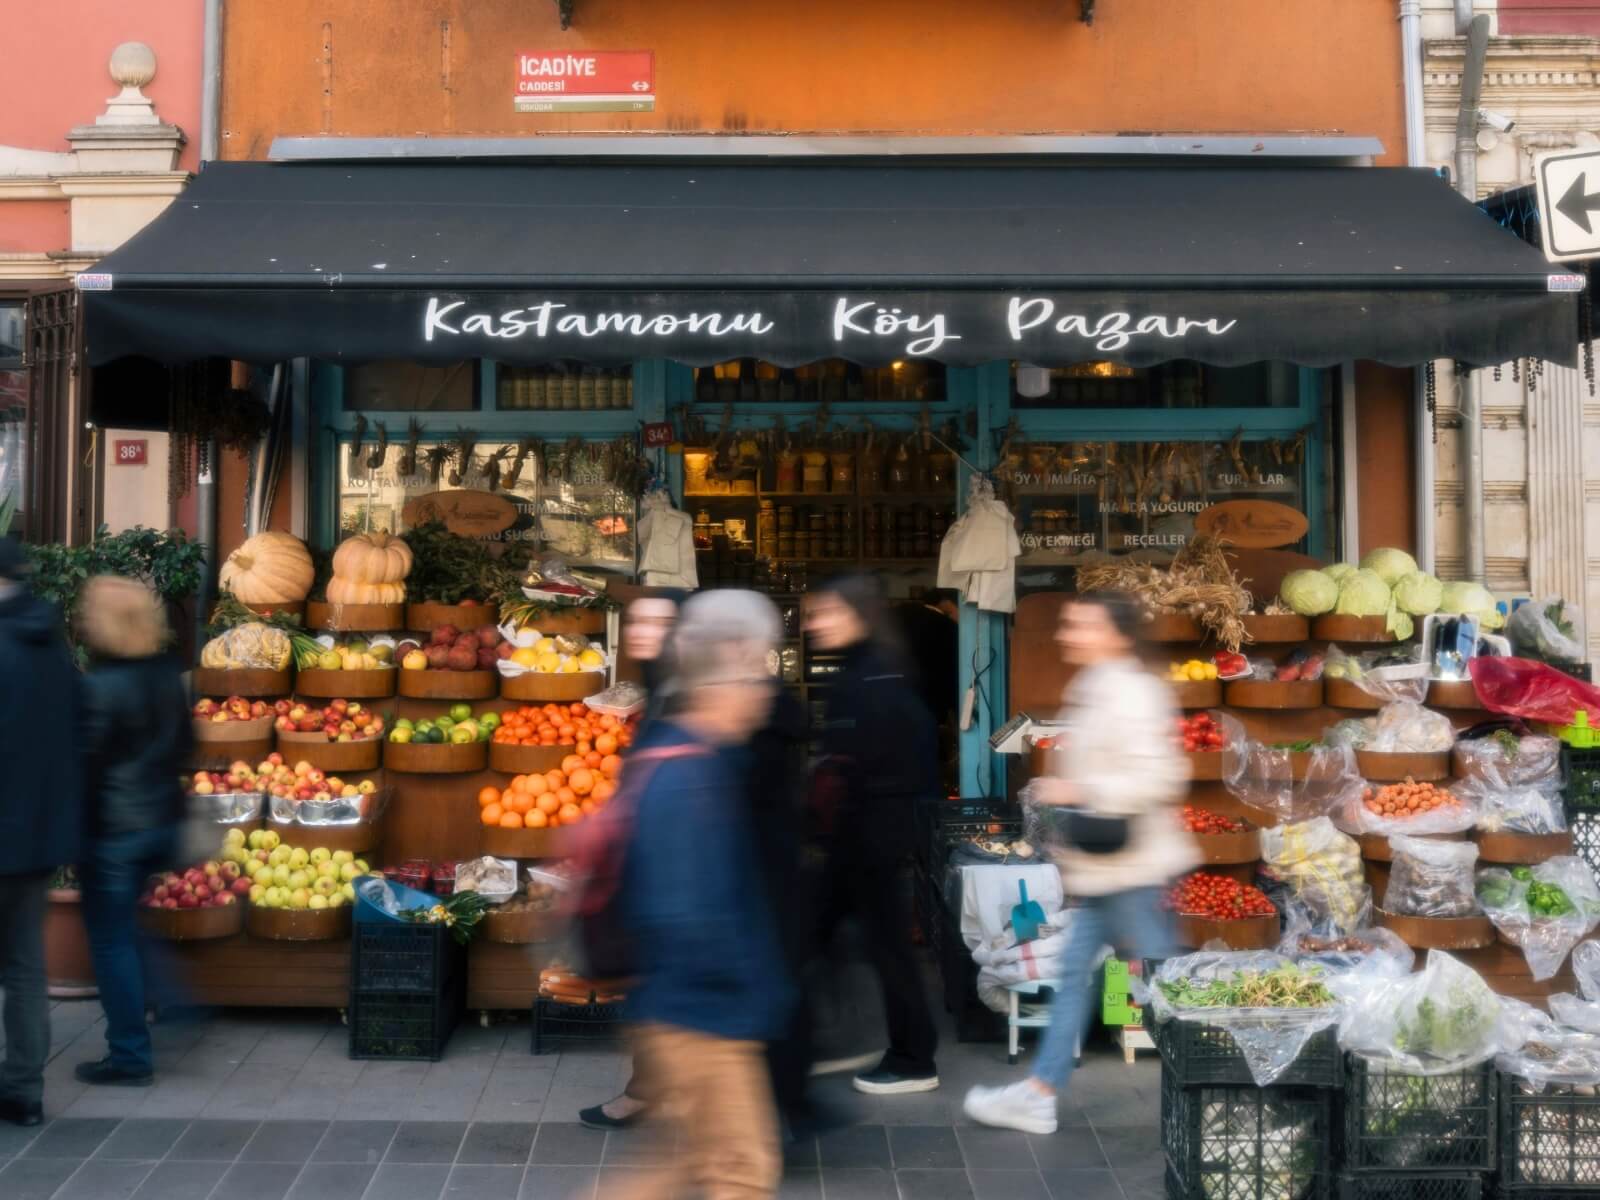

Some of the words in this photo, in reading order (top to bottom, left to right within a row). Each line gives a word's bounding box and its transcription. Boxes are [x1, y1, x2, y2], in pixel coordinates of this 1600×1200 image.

[520, 54, 596, 76] İCADİYE
[424, 297, 774, 341] Kastamonu
[833, 297, 961, 355] Köy
[1007, 297, 1238, 351] Pazarı
[1123, 534, 1186, 549] REÇELLER
